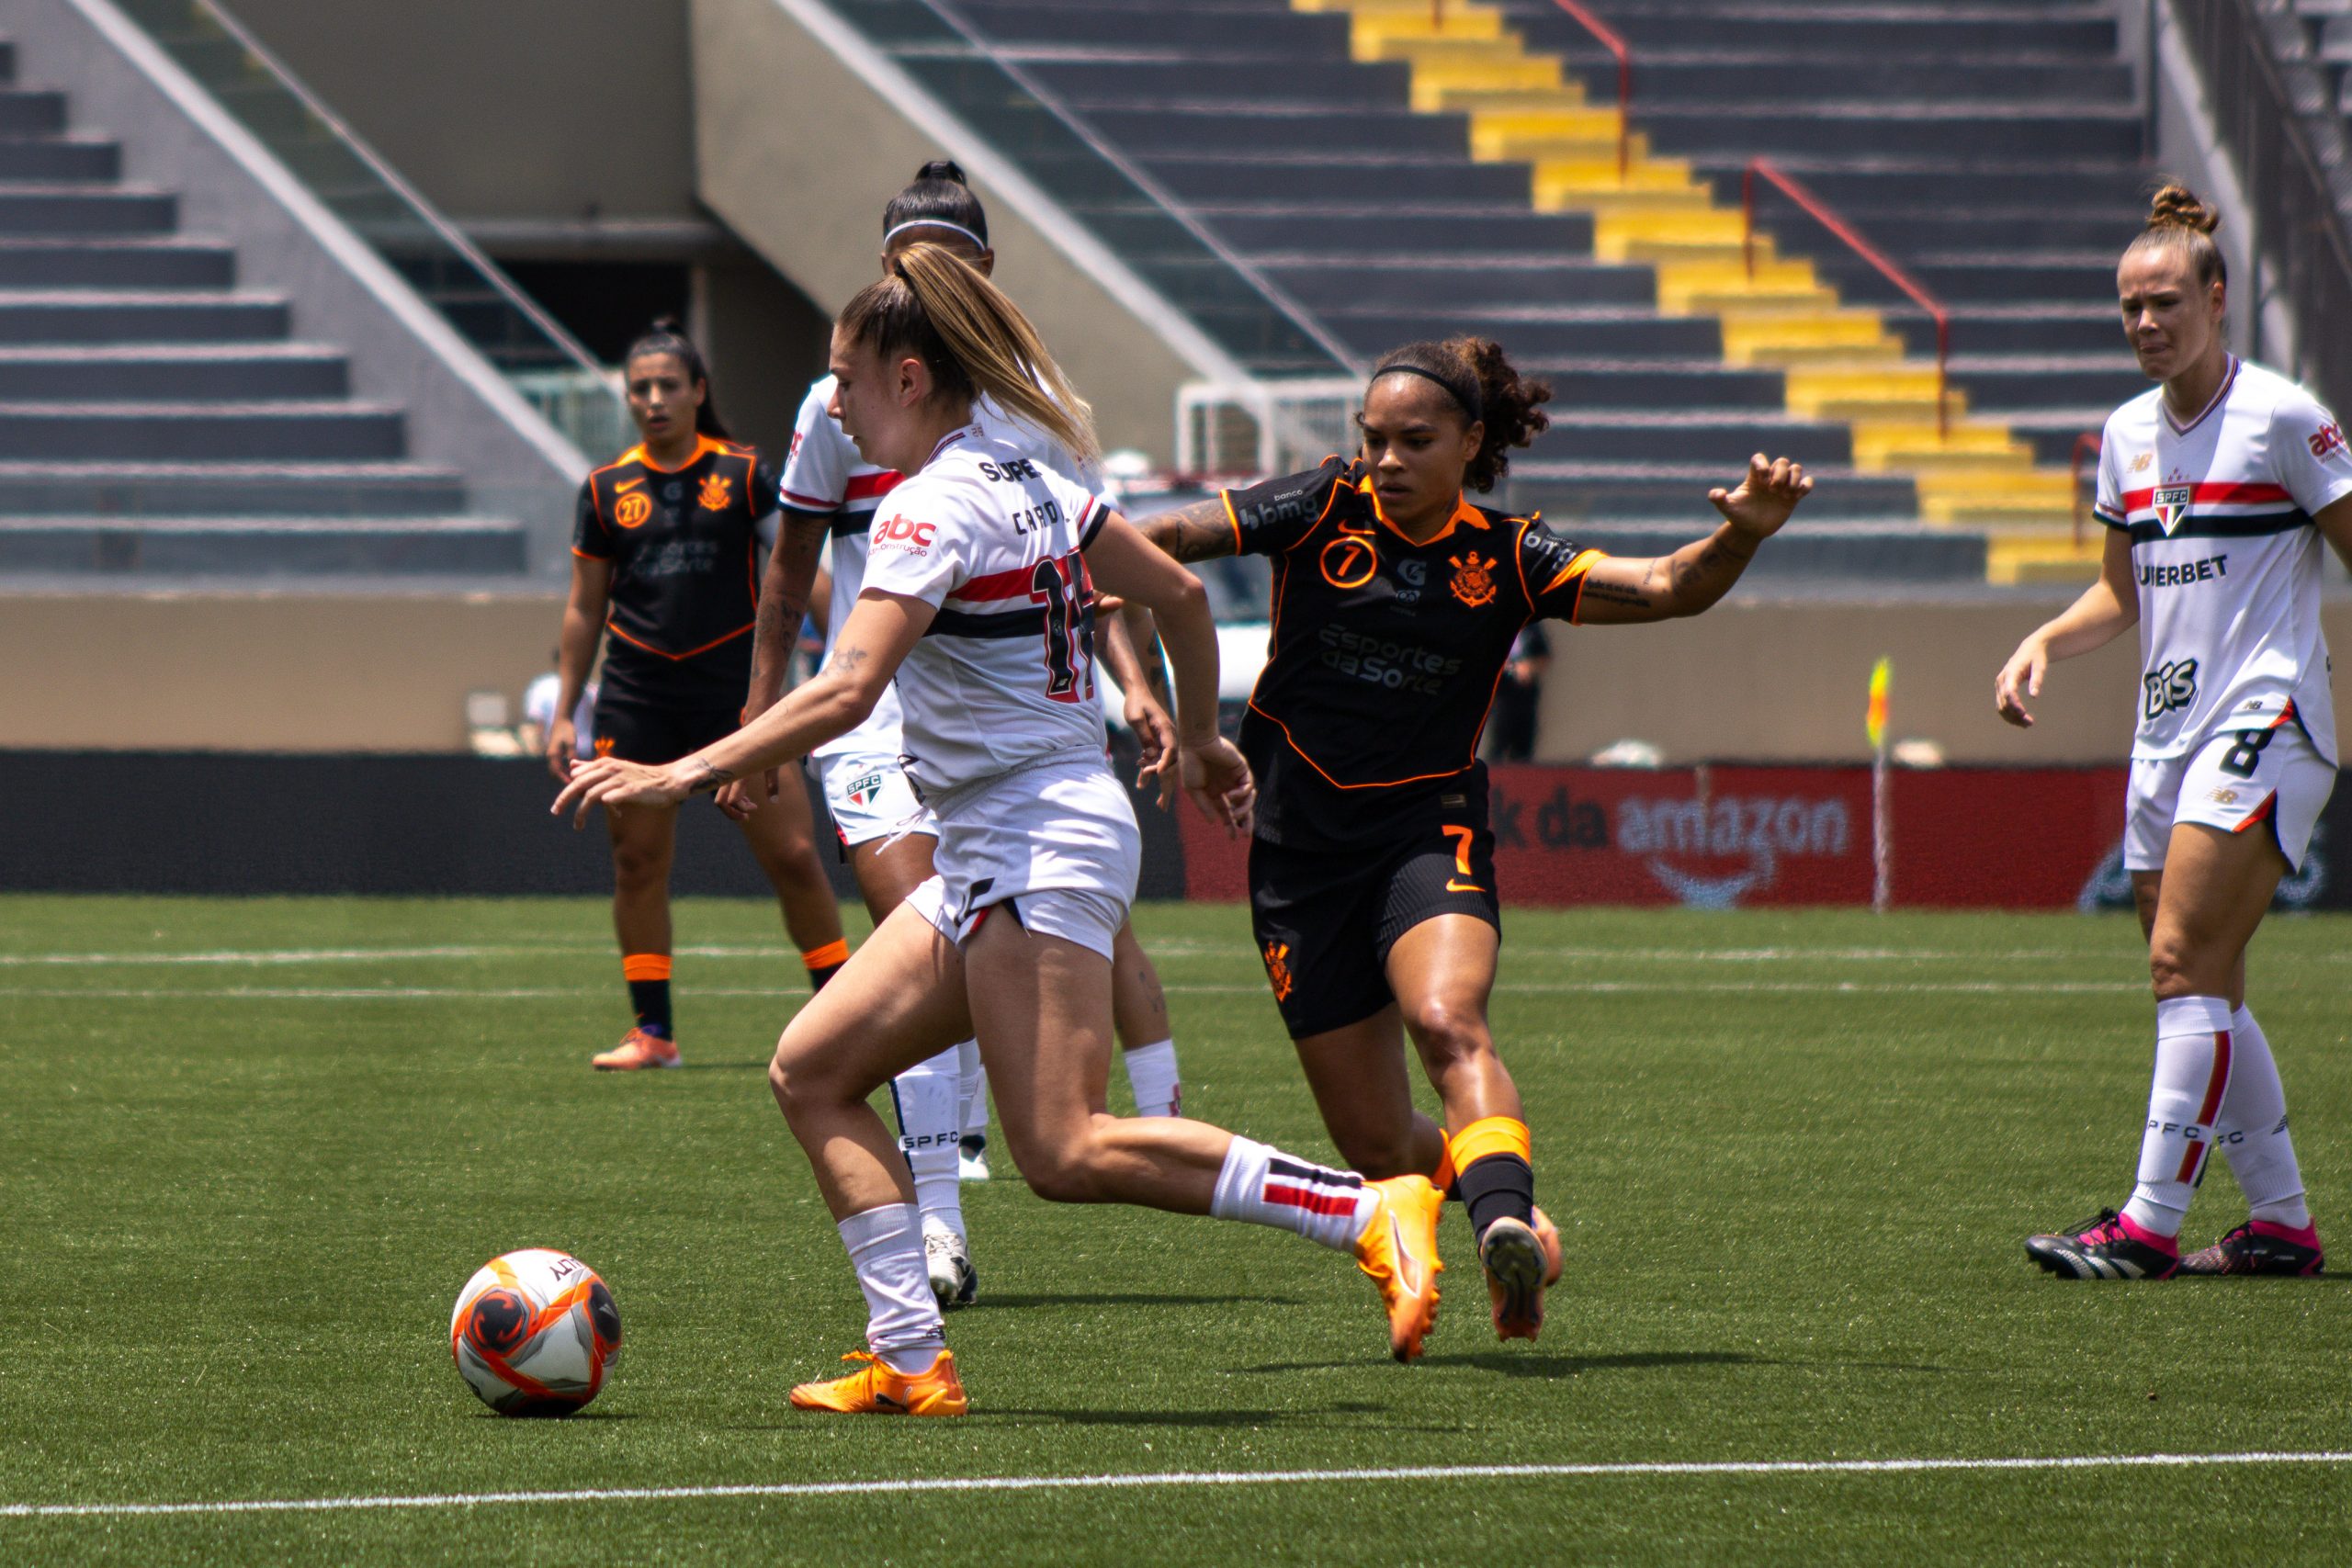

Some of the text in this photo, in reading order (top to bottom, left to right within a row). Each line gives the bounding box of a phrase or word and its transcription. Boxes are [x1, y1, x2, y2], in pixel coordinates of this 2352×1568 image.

[978, 458, 1042, 482] SUPE
[1273, 490, 1303, 502] banco
[2155, 491, 2188, 503] SPFC
[621, 499, 642, 523] 27
[1012, 501, 1070, 536] CARO
[874, 513, 936, 547] abc
[875, 543, 927, 558] onstrução
[2218, 728, 2277, 780] 8
[847, 773, 881, 795] SPFC
[1490, 785, 1849, 856] k da amazon
[1441, 824, 1475, 874] 7
[903, 1130, 958, 1149] SPFC
[2148, 1120, 2200, 1139] PFC
[2217, 1131, 2244, 1145] FC
